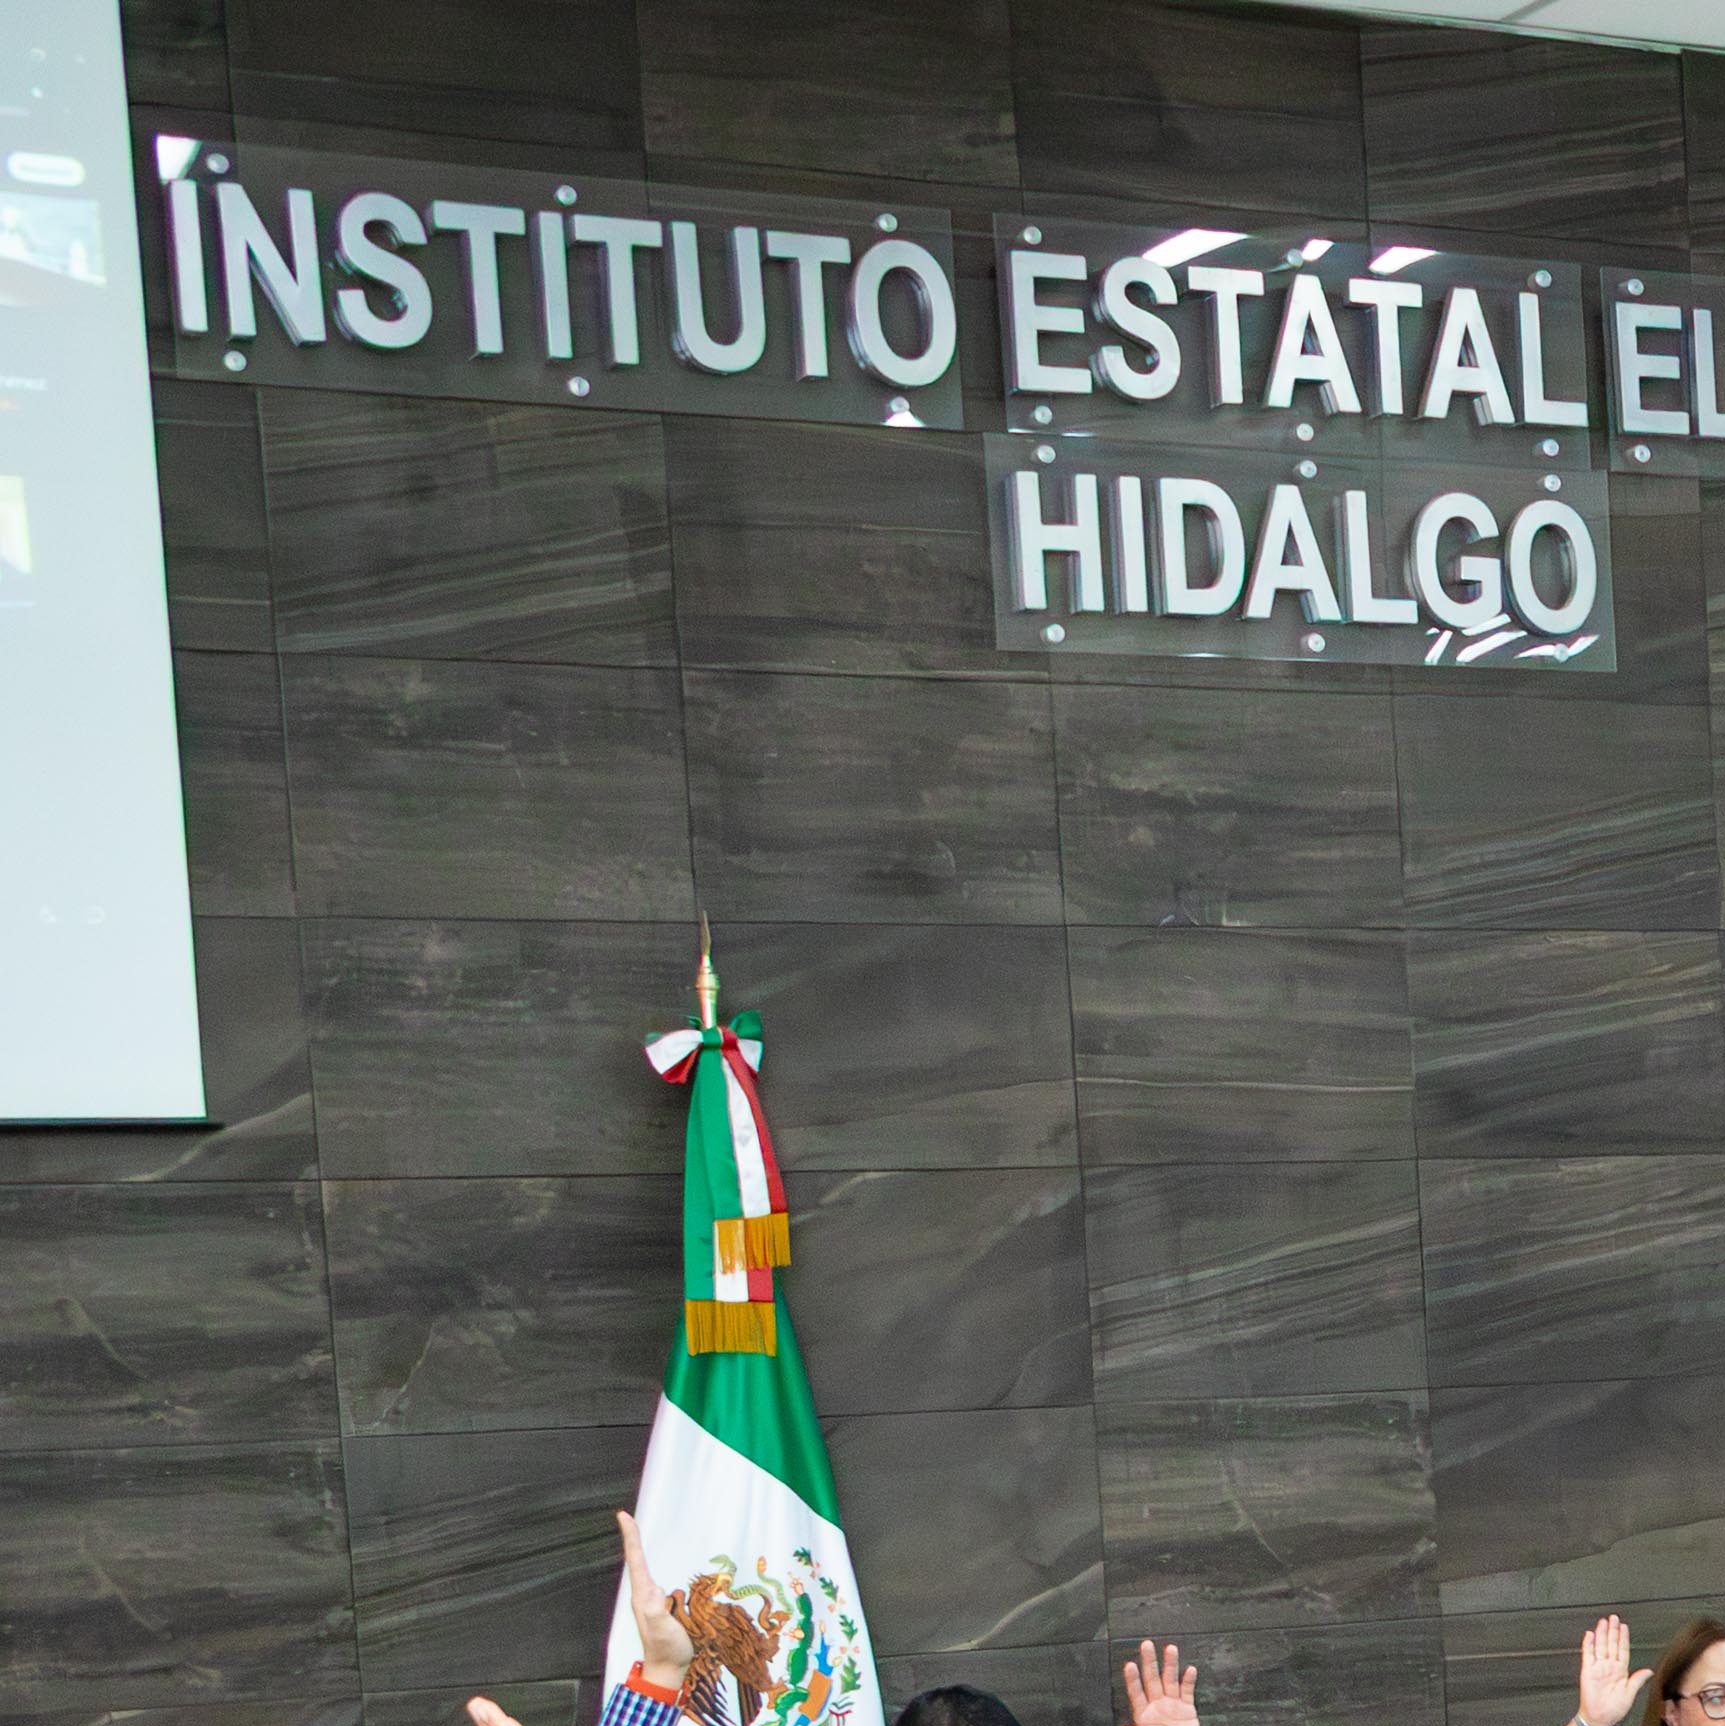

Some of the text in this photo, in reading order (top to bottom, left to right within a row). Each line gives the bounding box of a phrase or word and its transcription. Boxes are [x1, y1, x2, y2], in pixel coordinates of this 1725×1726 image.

[170, 180, 957, 388] INSTITUTO
[1009, 251, 1588, 427] ESTATAL
[1009, 470, 1596, 634] HIDALGO
